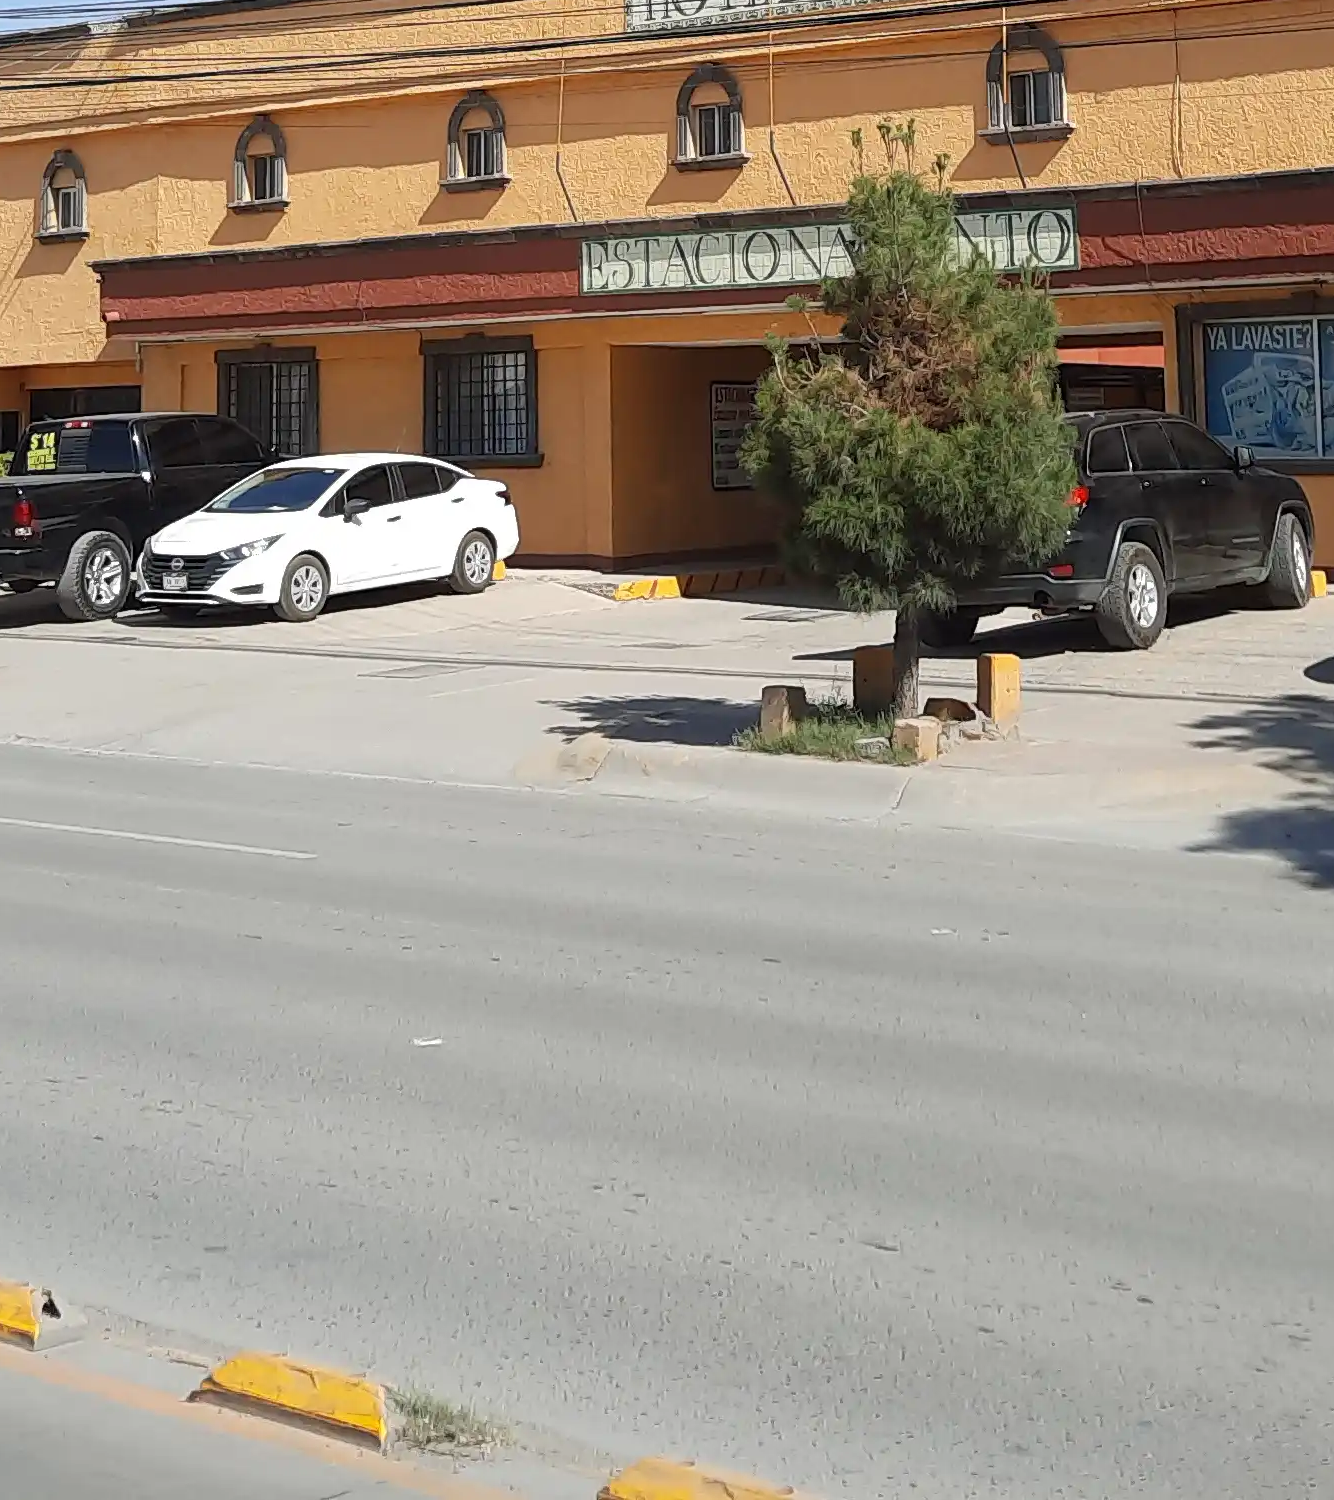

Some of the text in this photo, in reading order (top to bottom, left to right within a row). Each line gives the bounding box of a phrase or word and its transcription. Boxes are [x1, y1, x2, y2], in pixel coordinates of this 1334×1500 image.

[585, 208, 1071, 291] ESTACIONANTO
[1207, 323, 1312, 350] YA LAVASTE?
